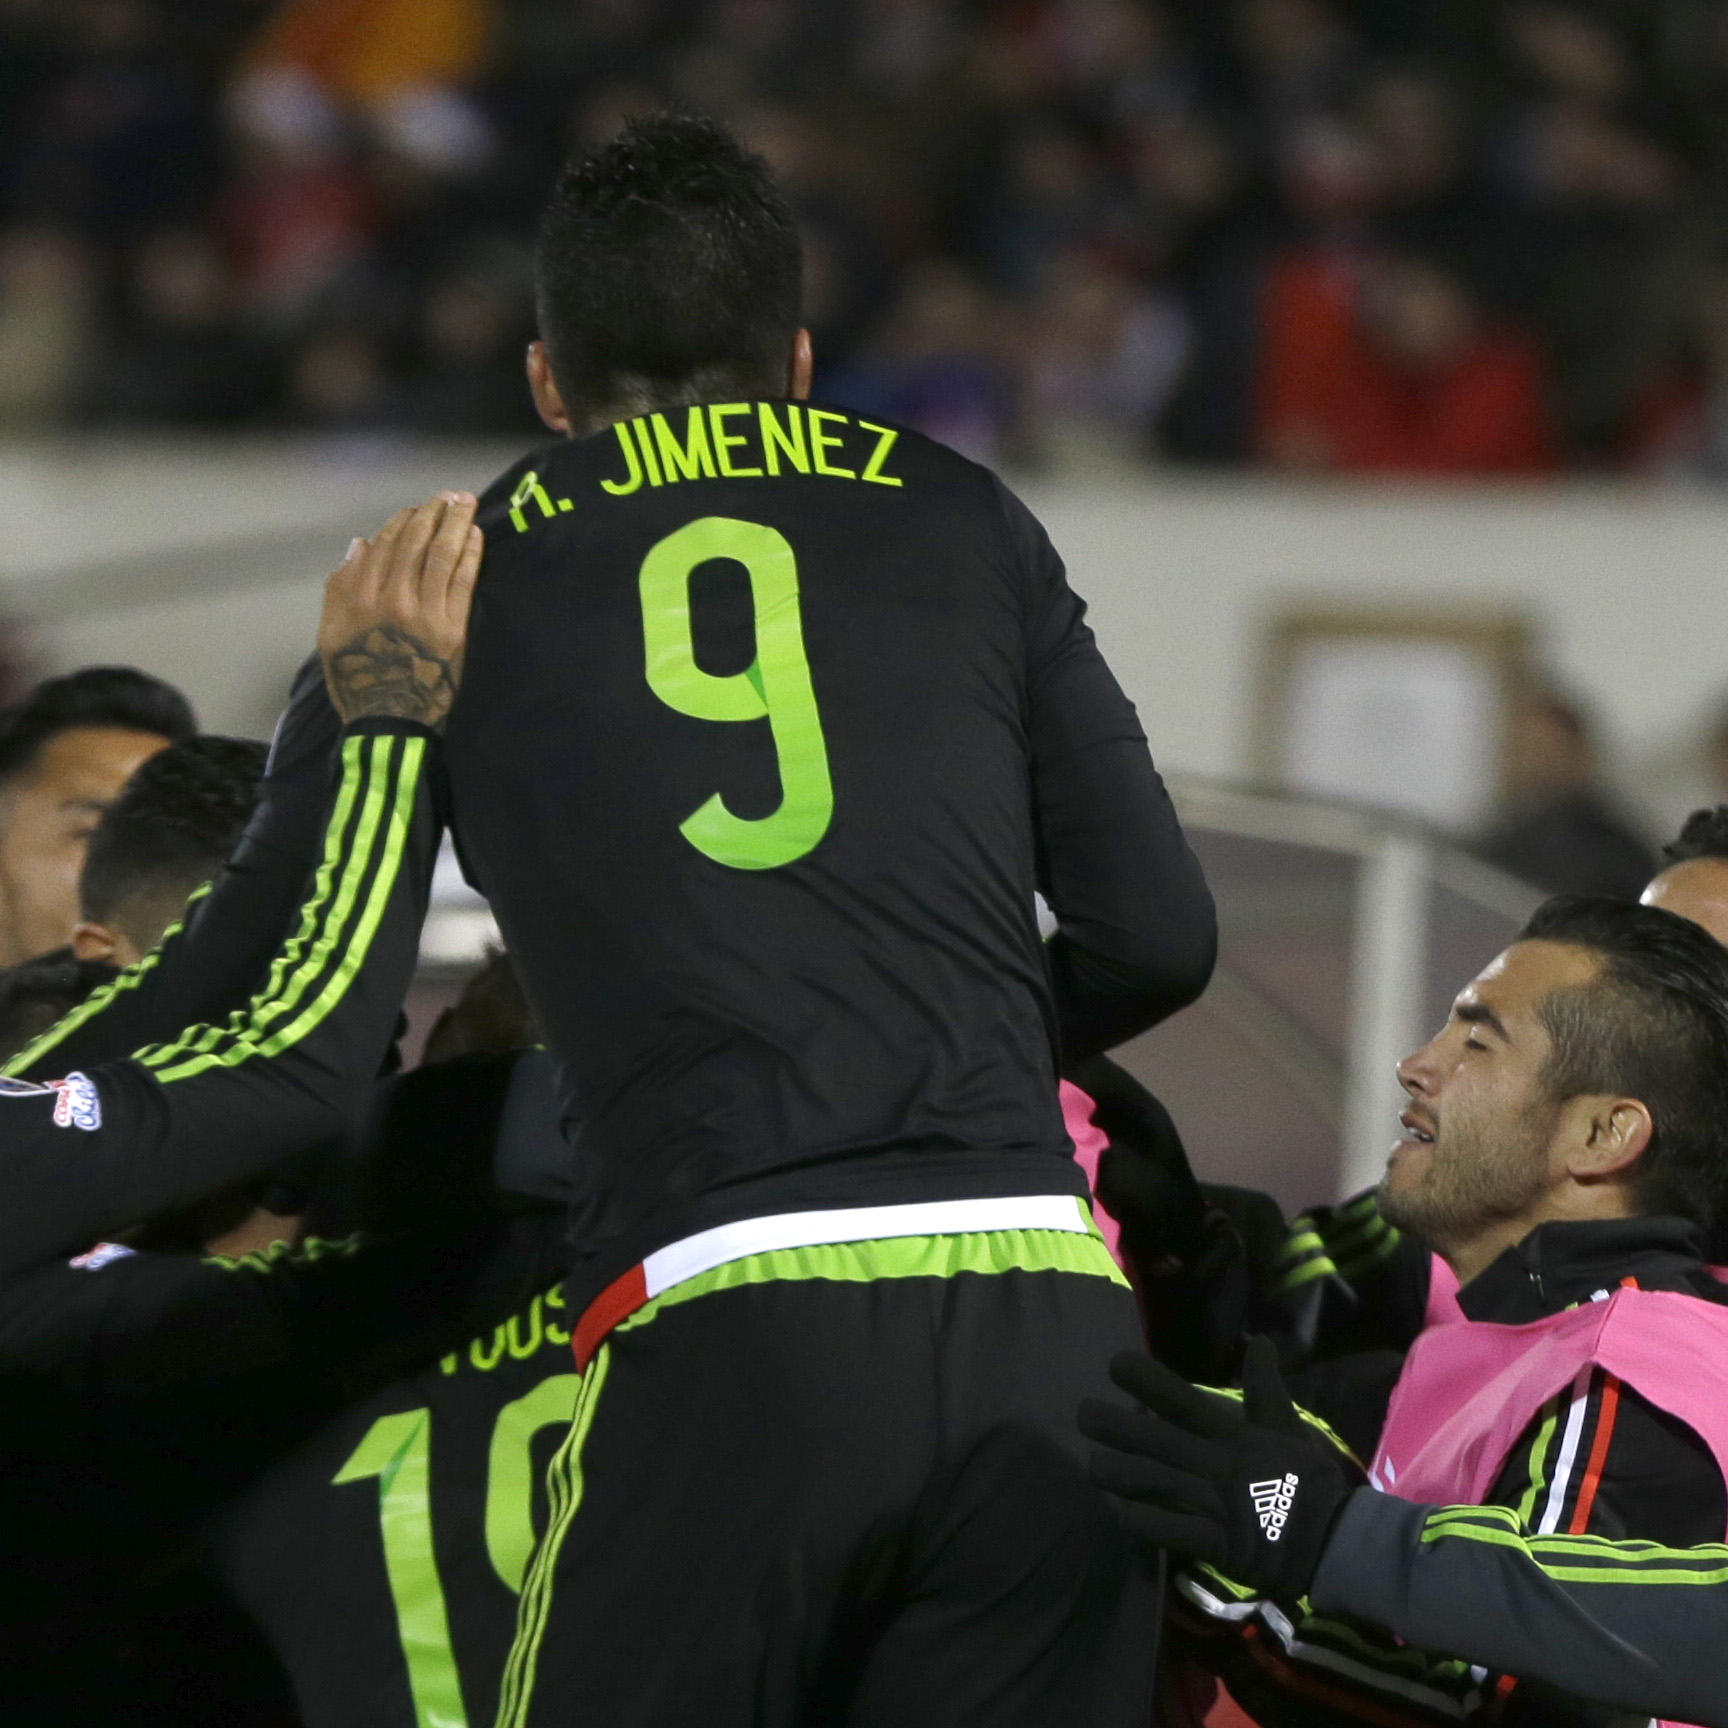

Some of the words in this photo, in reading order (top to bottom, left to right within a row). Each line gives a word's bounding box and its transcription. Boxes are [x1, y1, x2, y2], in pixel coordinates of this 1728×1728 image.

[600, 402, 904, 497] JIMENEZ
[639, 516, 834, 870] 9
[1266, 1472, 1299, 1541] adidas
